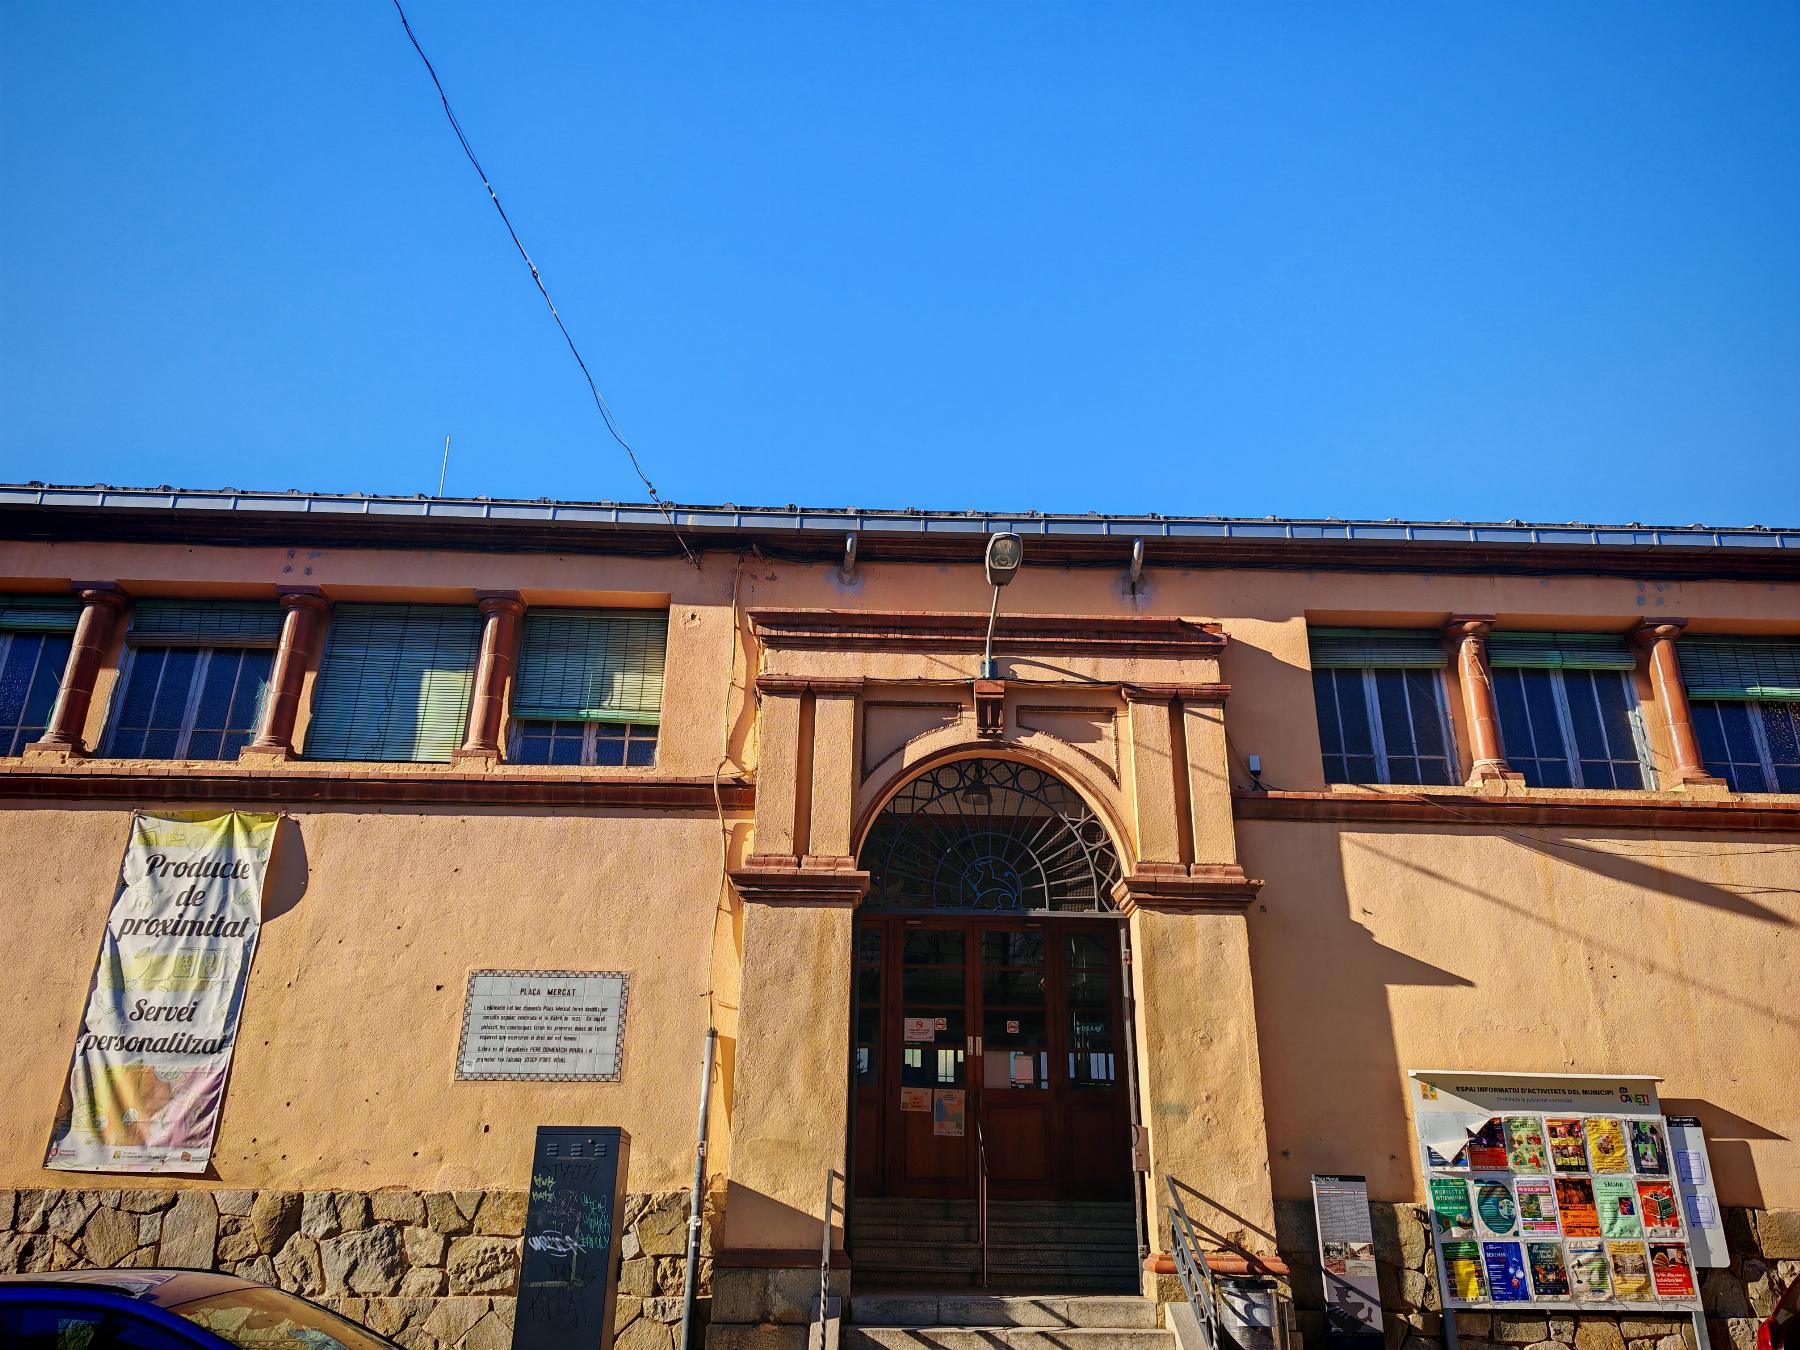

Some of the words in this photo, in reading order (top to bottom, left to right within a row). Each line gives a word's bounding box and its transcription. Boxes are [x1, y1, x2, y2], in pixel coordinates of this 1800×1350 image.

[145, 853, 250, 880] Producte
[175, 885, 206, 907] de
[118, 914, 251, 942] proximitat
[547, 988, 577, 997] MERCAT
[129, 998, 198, 1023] Servei
[80, 1031, 227, 1056] personalitzat
[1455, 1085, 1476, 1093] ESPAI
[1476, 1086, 1520, 1094] INFORMATIU
[1520, 1087, 1567, 1095] D'ACTIVITATS
[1567, 1088, 1581, 1096] DEL
[1582, 1088, 1614, 1097] MUNICIPI
